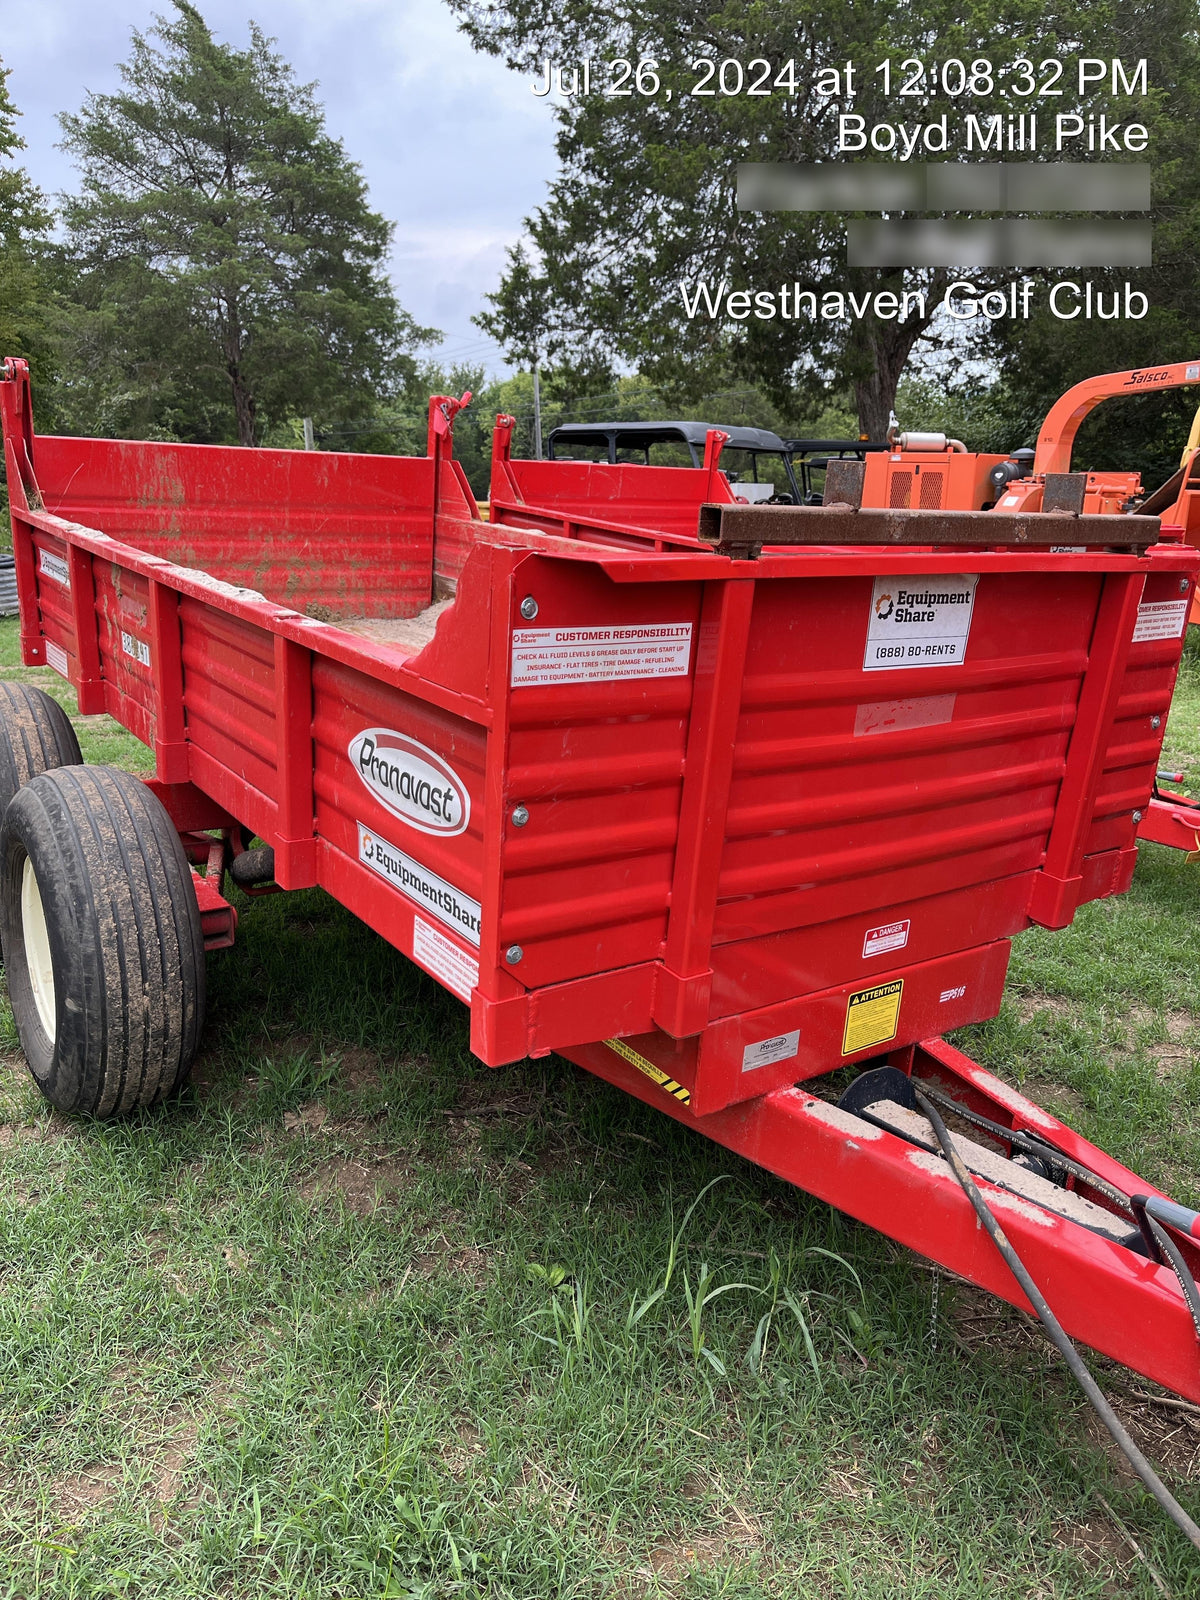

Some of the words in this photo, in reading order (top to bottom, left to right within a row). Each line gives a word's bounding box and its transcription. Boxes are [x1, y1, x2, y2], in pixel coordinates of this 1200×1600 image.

[1123, 371, 1169, 386] Salsco
[896, 590, 971, 608] Equipment
[895, 608, 935, 623] Share
[555, 631, 611, 642] CUSTOMER
[612, 627, 691, 639] RESPONSIBILITY
[517, 653, 537, 661] CHECK
[538, 652, 549, 660] ALL
[876, 646, 905, 660] (888)
[908, 644, 956, 657] 80-RENTS
[526, 663, 561, 671] INSURANCE
[645, 656, 675, 664] REFUELING
[513, 675, 538, 683] DAMAGE
[549, 672, 584, 681] EQUIPMENT
[588, 670, 614, 678] BATTERY
[614, 668, 654, 676] MAINTENANCE
[879, 924, 904, 936] DANGER
[860, 983, 901, 1002] ATTENTION
